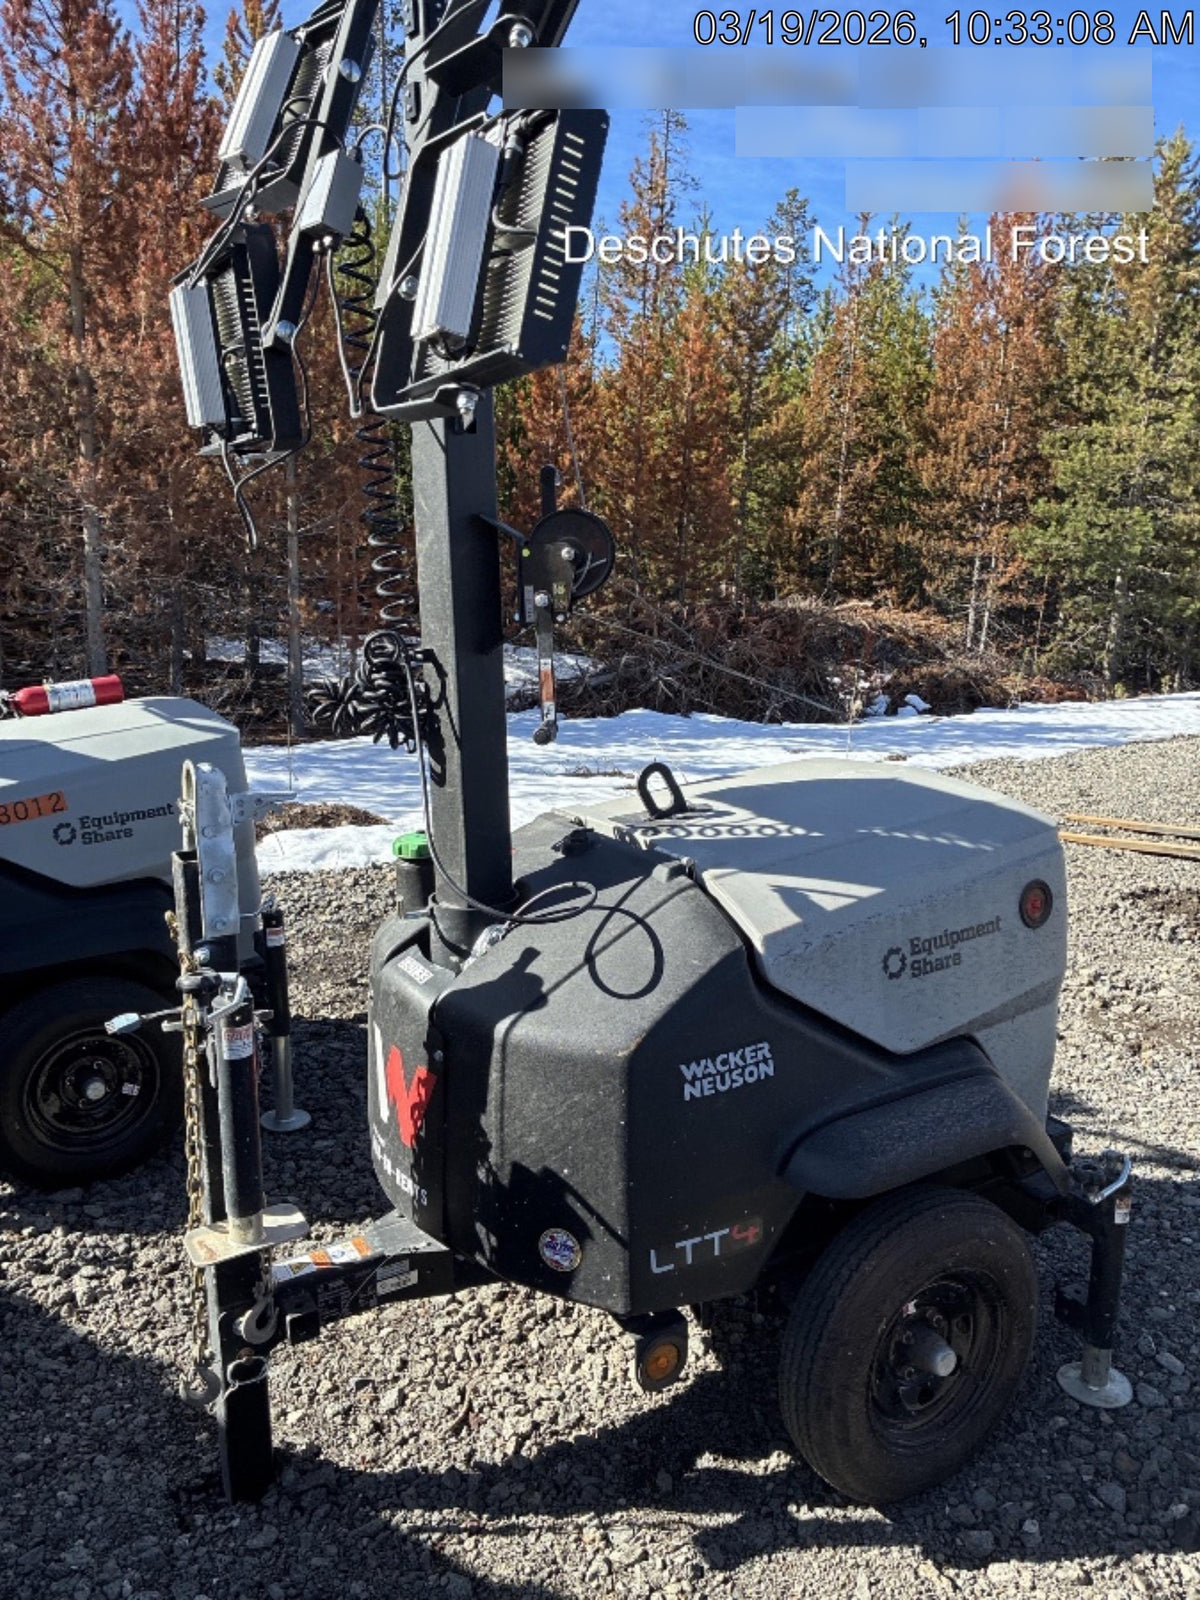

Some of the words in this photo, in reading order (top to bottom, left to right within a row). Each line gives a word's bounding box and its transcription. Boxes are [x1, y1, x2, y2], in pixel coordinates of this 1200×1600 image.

[79, 803, 175, 831] Equipment
[80, 828, 134, 845] Share
[909, 915, 1003, 956] Equipment
[910, 952, 962, 979] Share
[679, 1041, 773, 1082] WACKER
[683, 1059, 775, 1102] NEUSON
